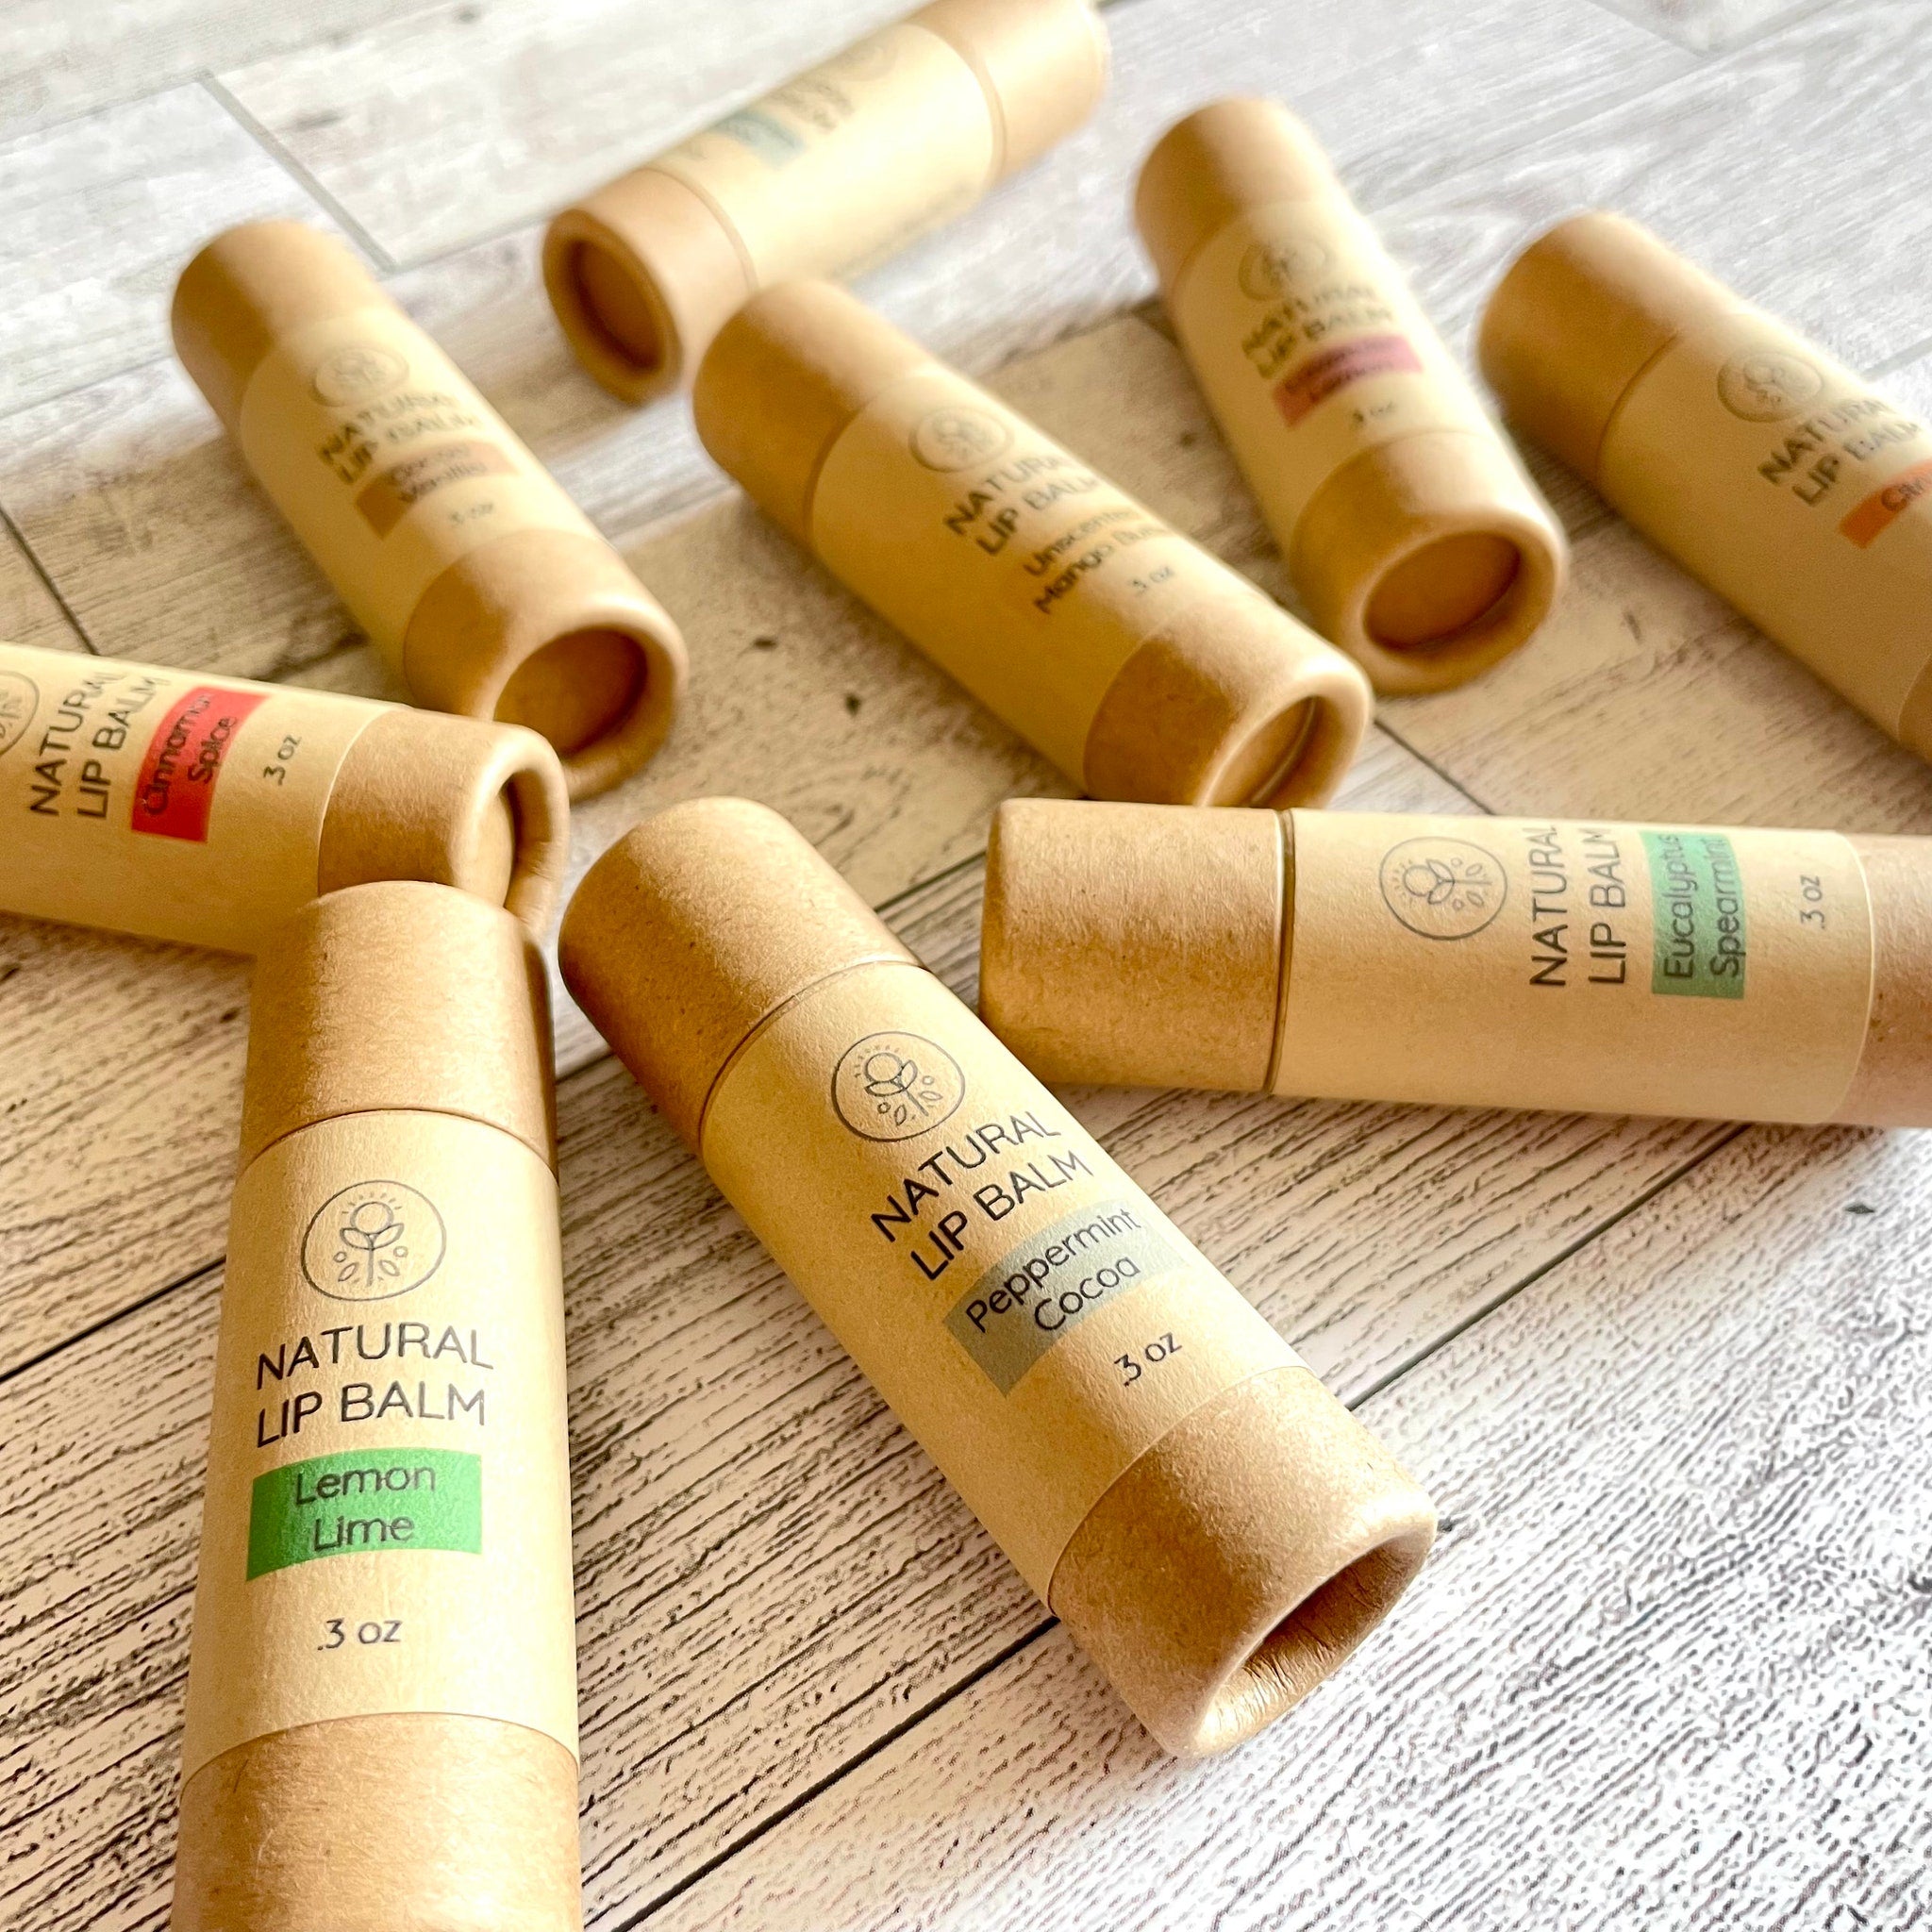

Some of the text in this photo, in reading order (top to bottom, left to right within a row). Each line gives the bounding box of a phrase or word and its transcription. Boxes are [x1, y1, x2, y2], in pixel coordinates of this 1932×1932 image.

[943, 455, 1068, 538] NATURA
[1791, 452, 1840, 508] LIP
[975, 506, 1020, 558] LIP
[1034, 542, 1117, 616] Mango
[76, 675, 172, 820] LIP BALM
[188, 716, 237, 785] Spice
[277, 734, 302, 760] oz
[1522, 825, 1569, 987] NATURAL
[1578, 827, 1627, 985] LIP BALM
[1657, 835, 1699, 979] Eucalyptus
[1698, 837, 1747, 979] Spearmint
[1799, 874, 1824, 902] oz
[871, 1110, 1062, 1243] NATURAL
[909, 1150, 1094, 1282] LIP BALM
[965, 1208, 1142, 1334] Peppermint
[1033, 1256, 1142, 1332] Cocoa
[256, 1321, 494, 1391] NATURAL
[1112, 1331, 1184, 1388] .3 oz
[257, 1379, 485, 1450] LIP BALM
[293, 1465, 437, 1507] Lemon
[312, 1514, 416, 1553] Lime
[316, 1617, 404, 1652] .3 oz
